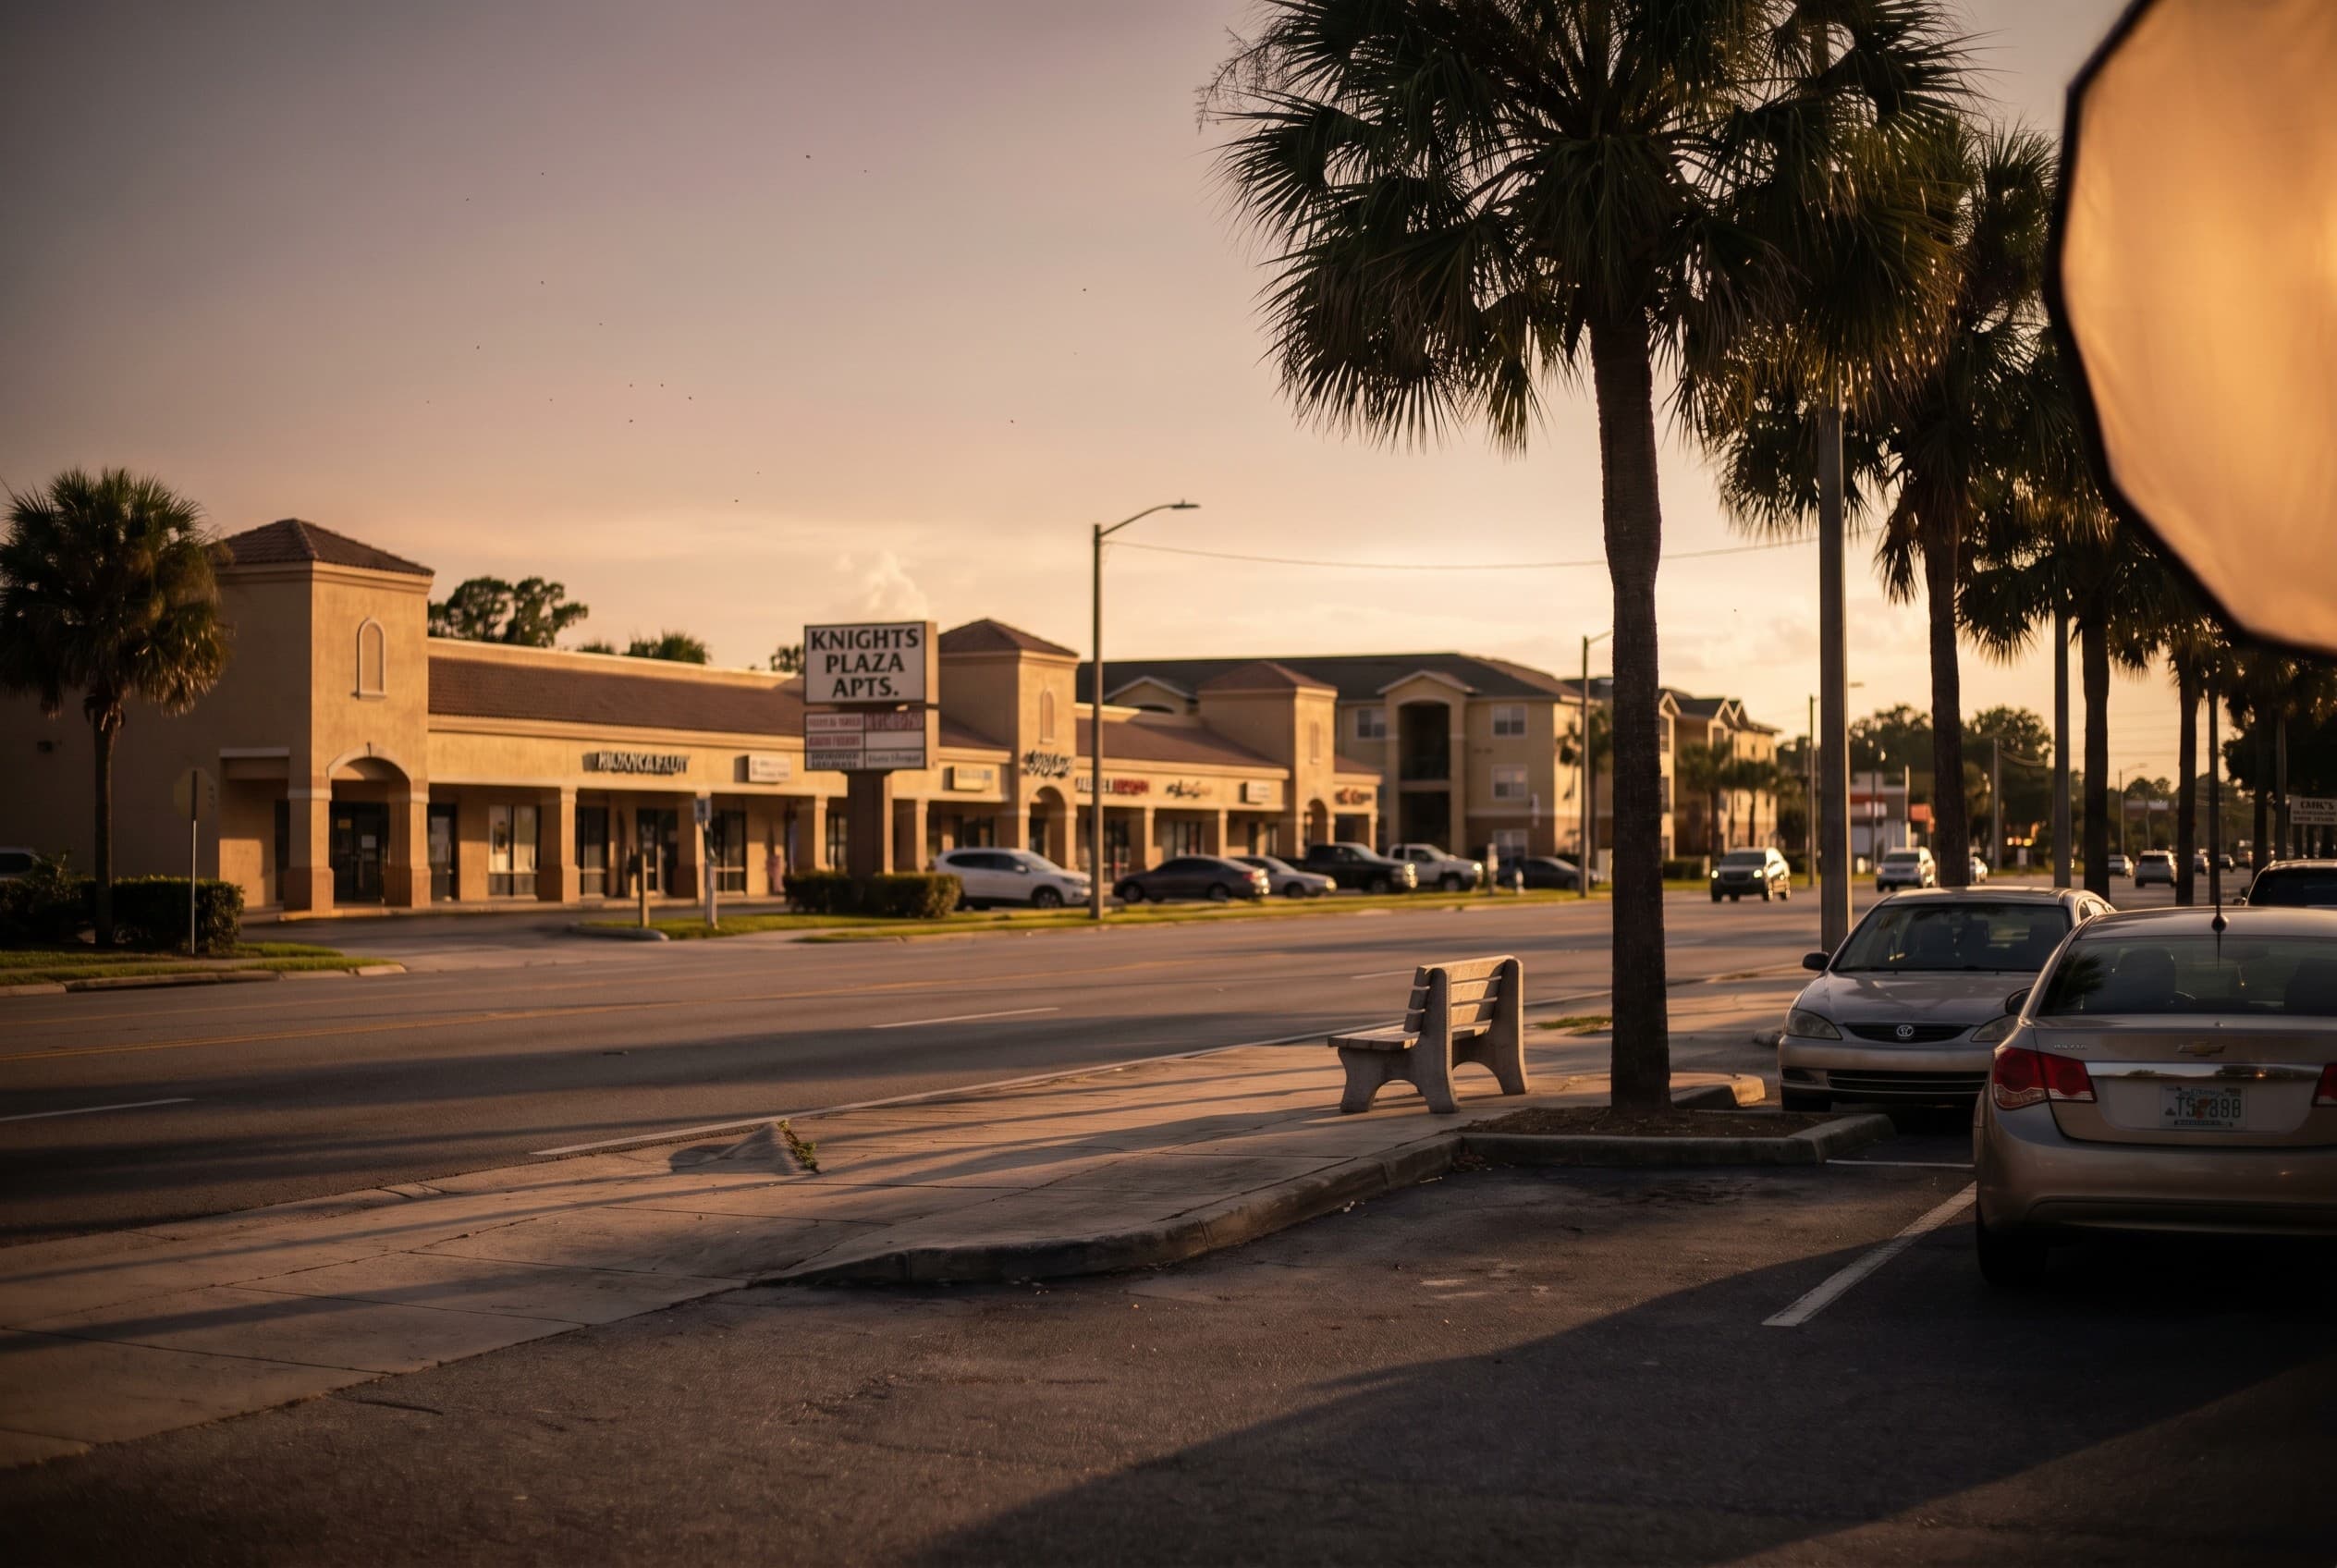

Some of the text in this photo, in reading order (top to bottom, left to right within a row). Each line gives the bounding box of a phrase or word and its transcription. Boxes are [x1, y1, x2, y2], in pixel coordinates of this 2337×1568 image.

[811, 628, 920, 651] KNIGHTS
[826, 653, 905, 674] PLAZA
[832, 676, 899, 698] APTS.
